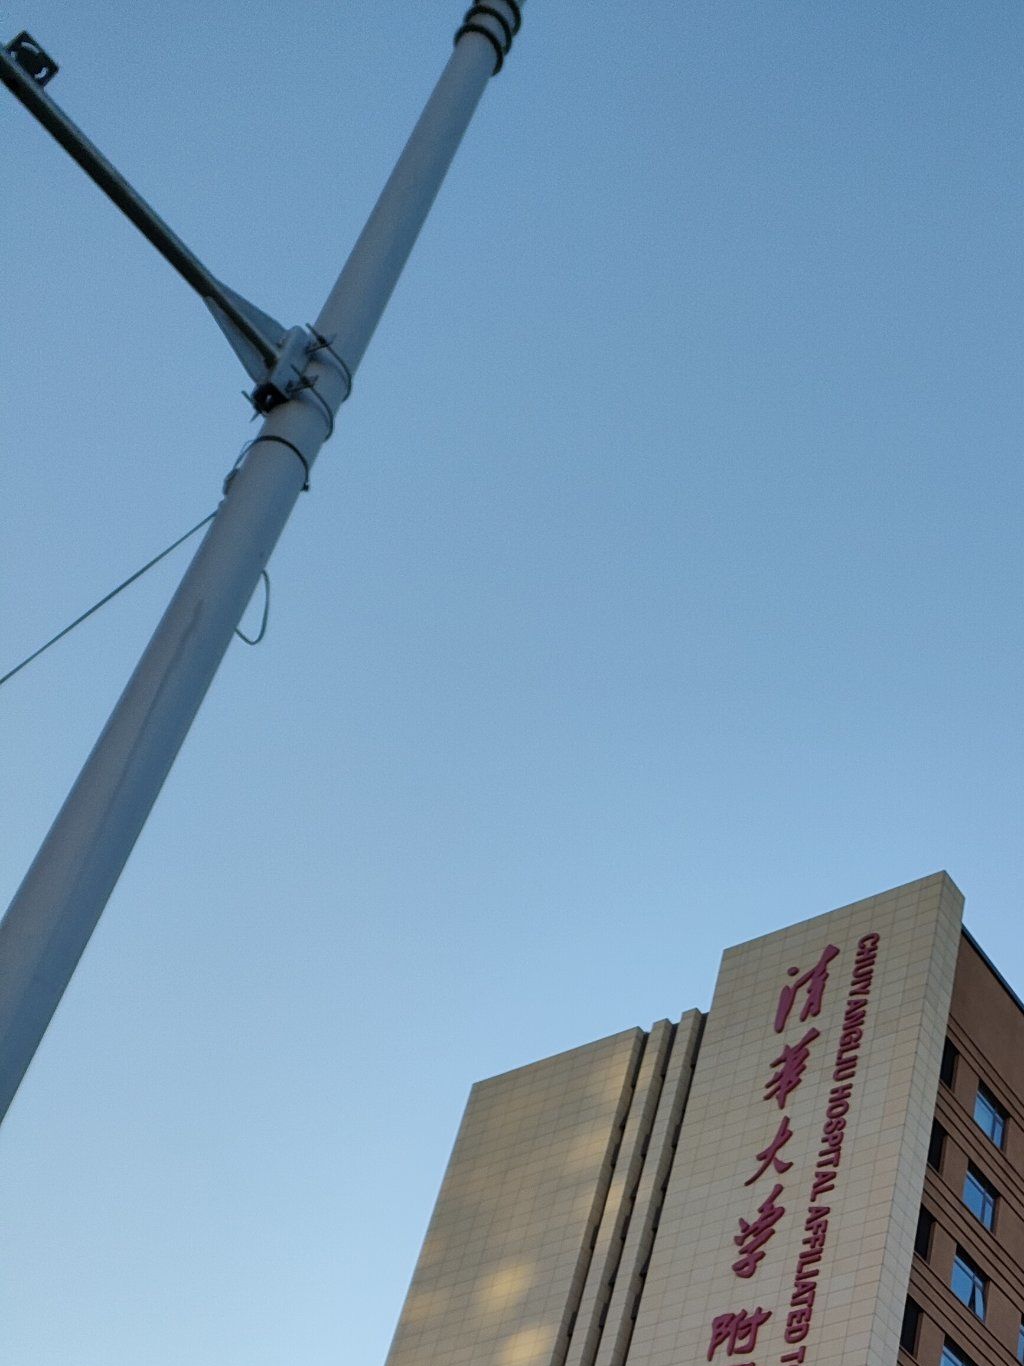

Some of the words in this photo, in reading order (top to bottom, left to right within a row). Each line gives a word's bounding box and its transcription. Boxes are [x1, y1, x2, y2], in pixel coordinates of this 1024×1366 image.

[832, 932, 880, 1083] CHUIYANGLIU
[810, 1083, 854, 1203] HOSPITAL
[783, 1206, 831, 1345] AFFILIATED
